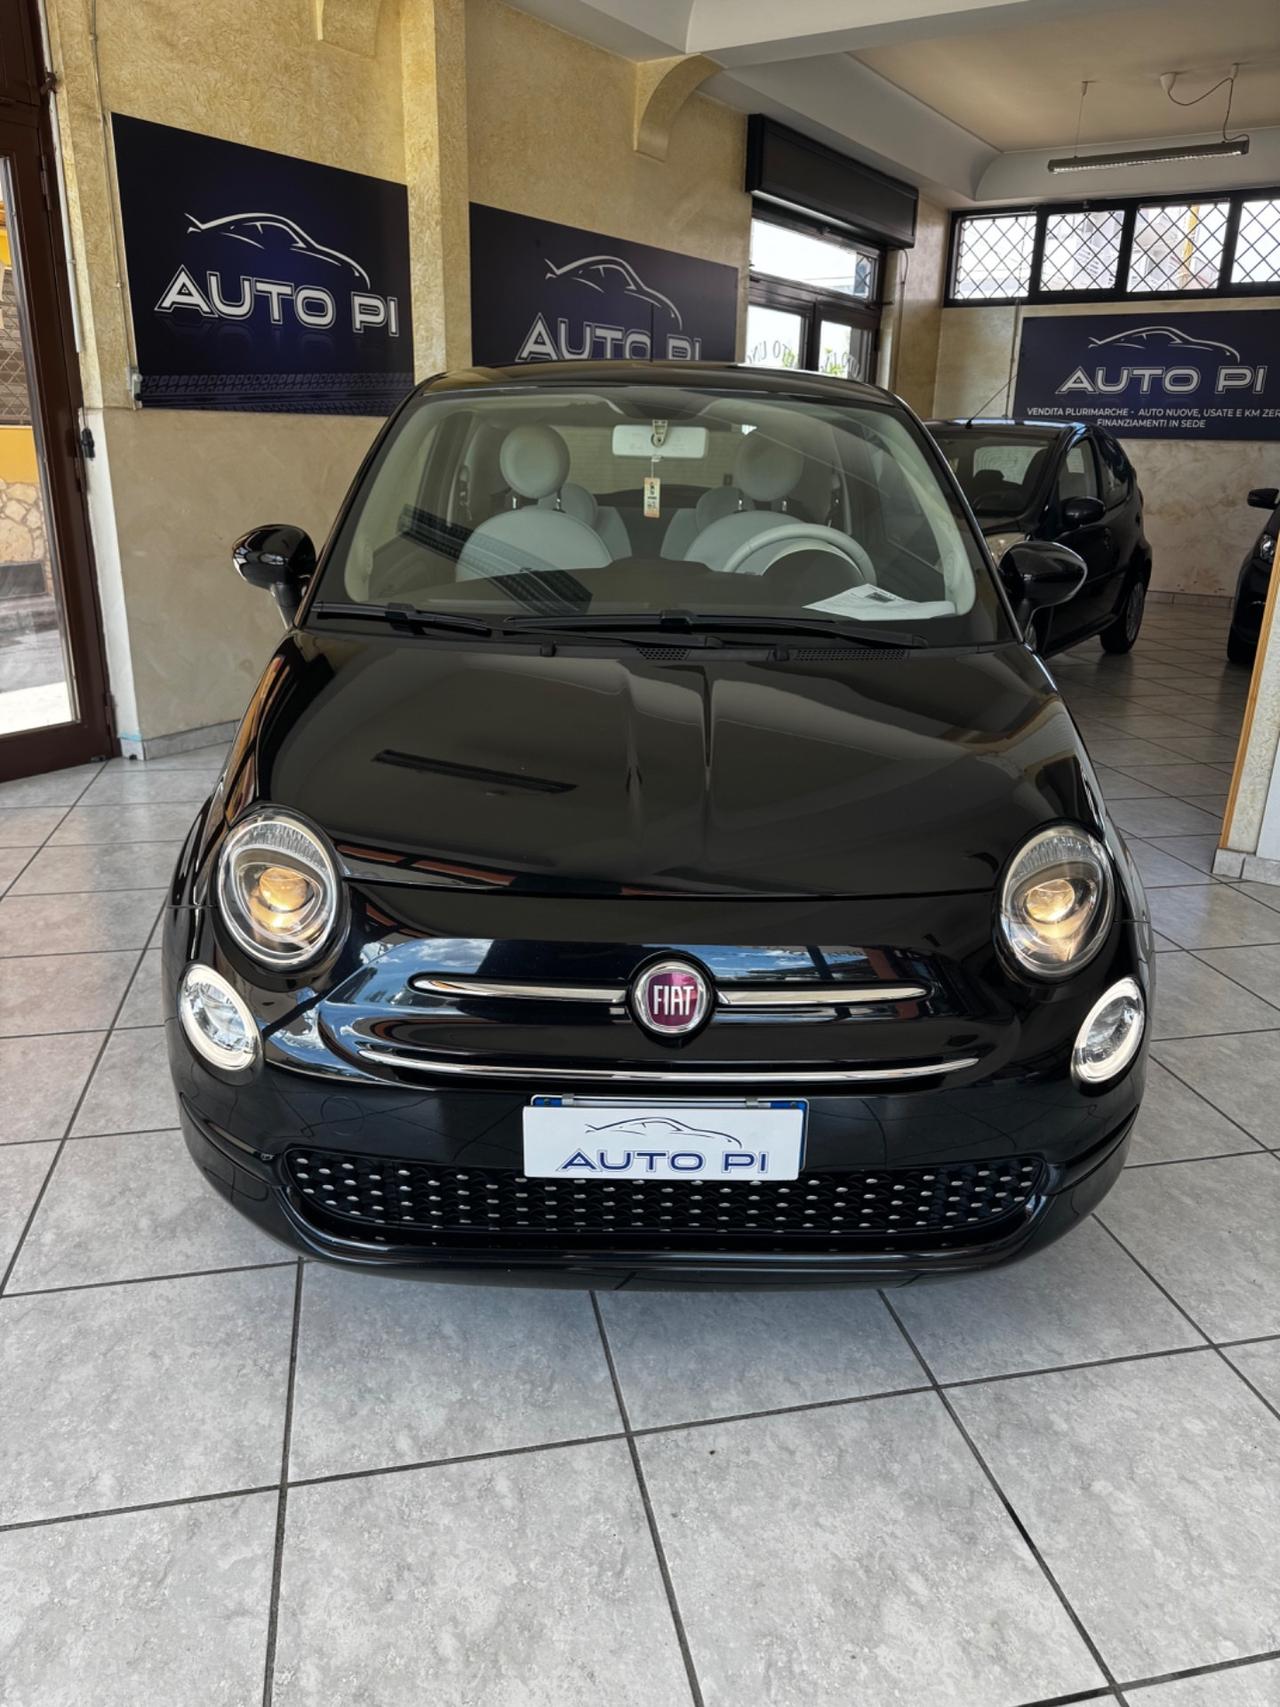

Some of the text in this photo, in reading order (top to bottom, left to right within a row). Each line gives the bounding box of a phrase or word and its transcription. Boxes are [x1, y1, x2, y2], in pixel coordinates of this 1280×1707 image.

[154, 263, 400, 337] AUTO PI
[514, 311, 652, 362] AUTO
[1054, 365, 1268, 395] AUTO PI
[1027, 407, 1063, 416] VENDITA
[1065, 407, 1128, 417] PLURIMARCHE
[1138, 408, 1163, 417] AUTO
[1165, 408, 1201, 418] NUOVE,
[1203, 408, 1234, 417] USATE
[1236, 408, 1242, 417] E
[1244, 408, 1260, 417] KM
[1096, 418, 1207, 428] FINANZIAMENTI IN SEDE
[652, 984, 695, 1016] FIAT
[556, 1147, 769, 1174] AUTO PI
